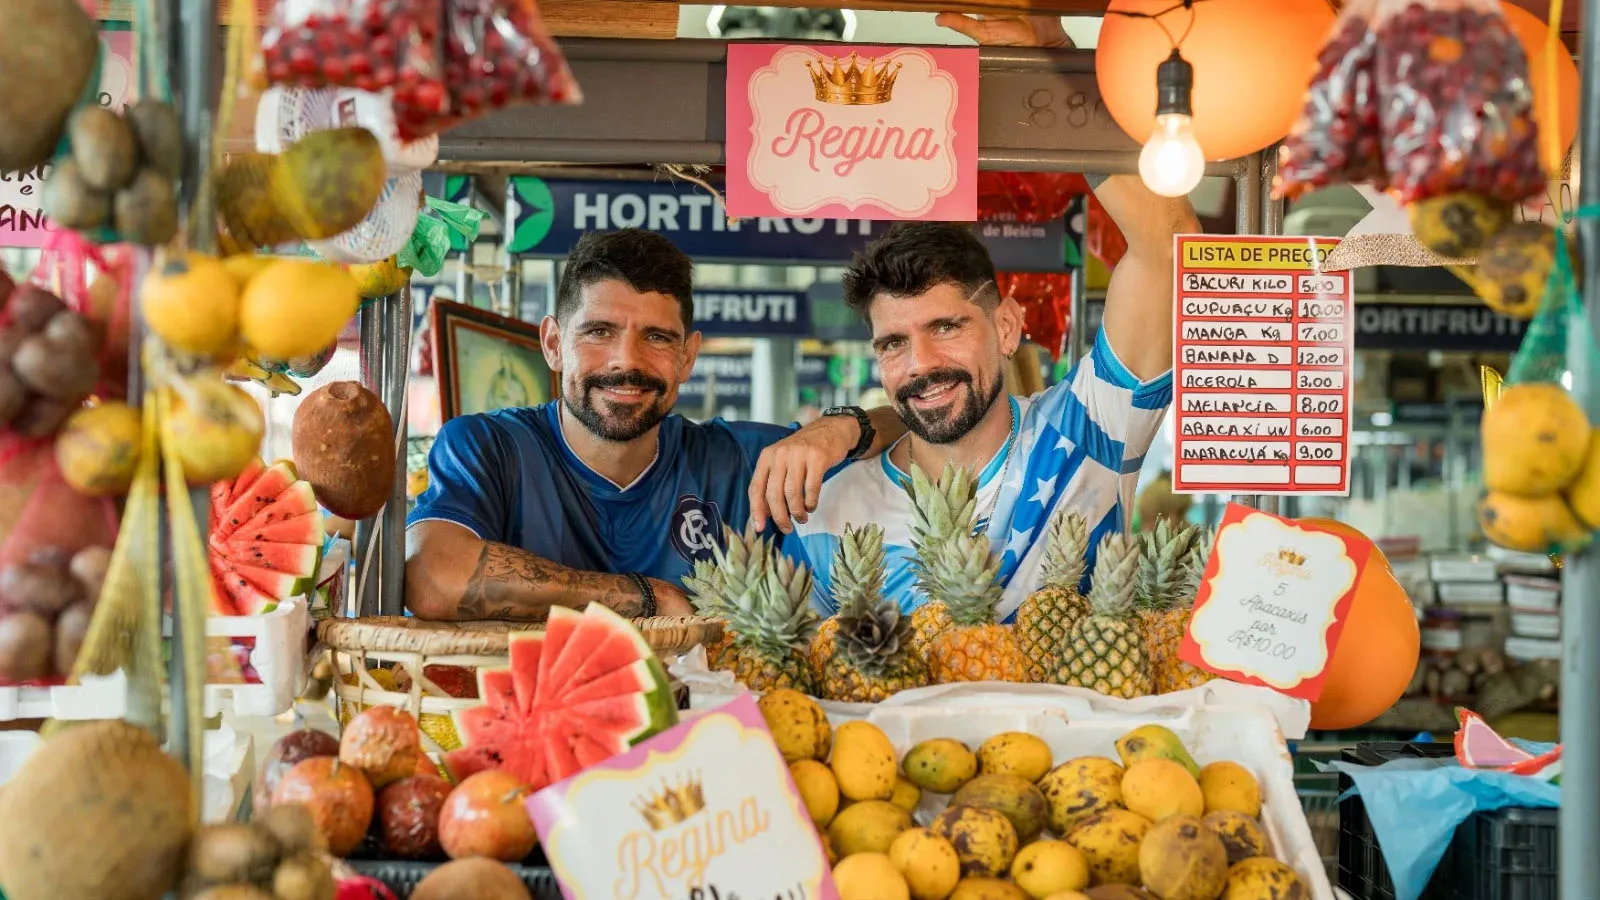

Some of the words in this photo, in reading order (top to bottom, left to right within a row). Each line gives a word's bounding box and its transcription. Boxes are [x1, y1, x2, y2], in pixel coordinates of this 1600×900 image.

[771, 107, 940, 177] Regina
[573, 193, 872, 236] HORTI
[1189, 246, 1235, 262] LISTA
[1240, 247, 1263, 262] DE
[1268, 248, 1334, 267] PREÇO
[1186, 273, 1245, 291] BACURI
[1252, 279, 1287, 291] KILO
[692, 293, 797, 323] IFRUTI
[1185, 302, 1267, 319] CUPUAÇU
[1272, 303, 1293, 322] Kg
[1357, 307, 1521, 335] ORTIFRUTI
[1186, 326, 1248, 341] MANGA
[1261, 326, 1281, 345] Kg
[1185, 348, 1257, 364] BANANA
[1267, 353, 1279, 364] D
[1185, 375, 1258, 389] ACEROLA
[1267, 425, 1289, 437] UN
[1183, 444, 1268, 463] MARACUJÁ
[1273, 449, 1290, 467] Kg
[1273, 582, 1289, 597] 5
[613, 796, 770, 900] Regina
